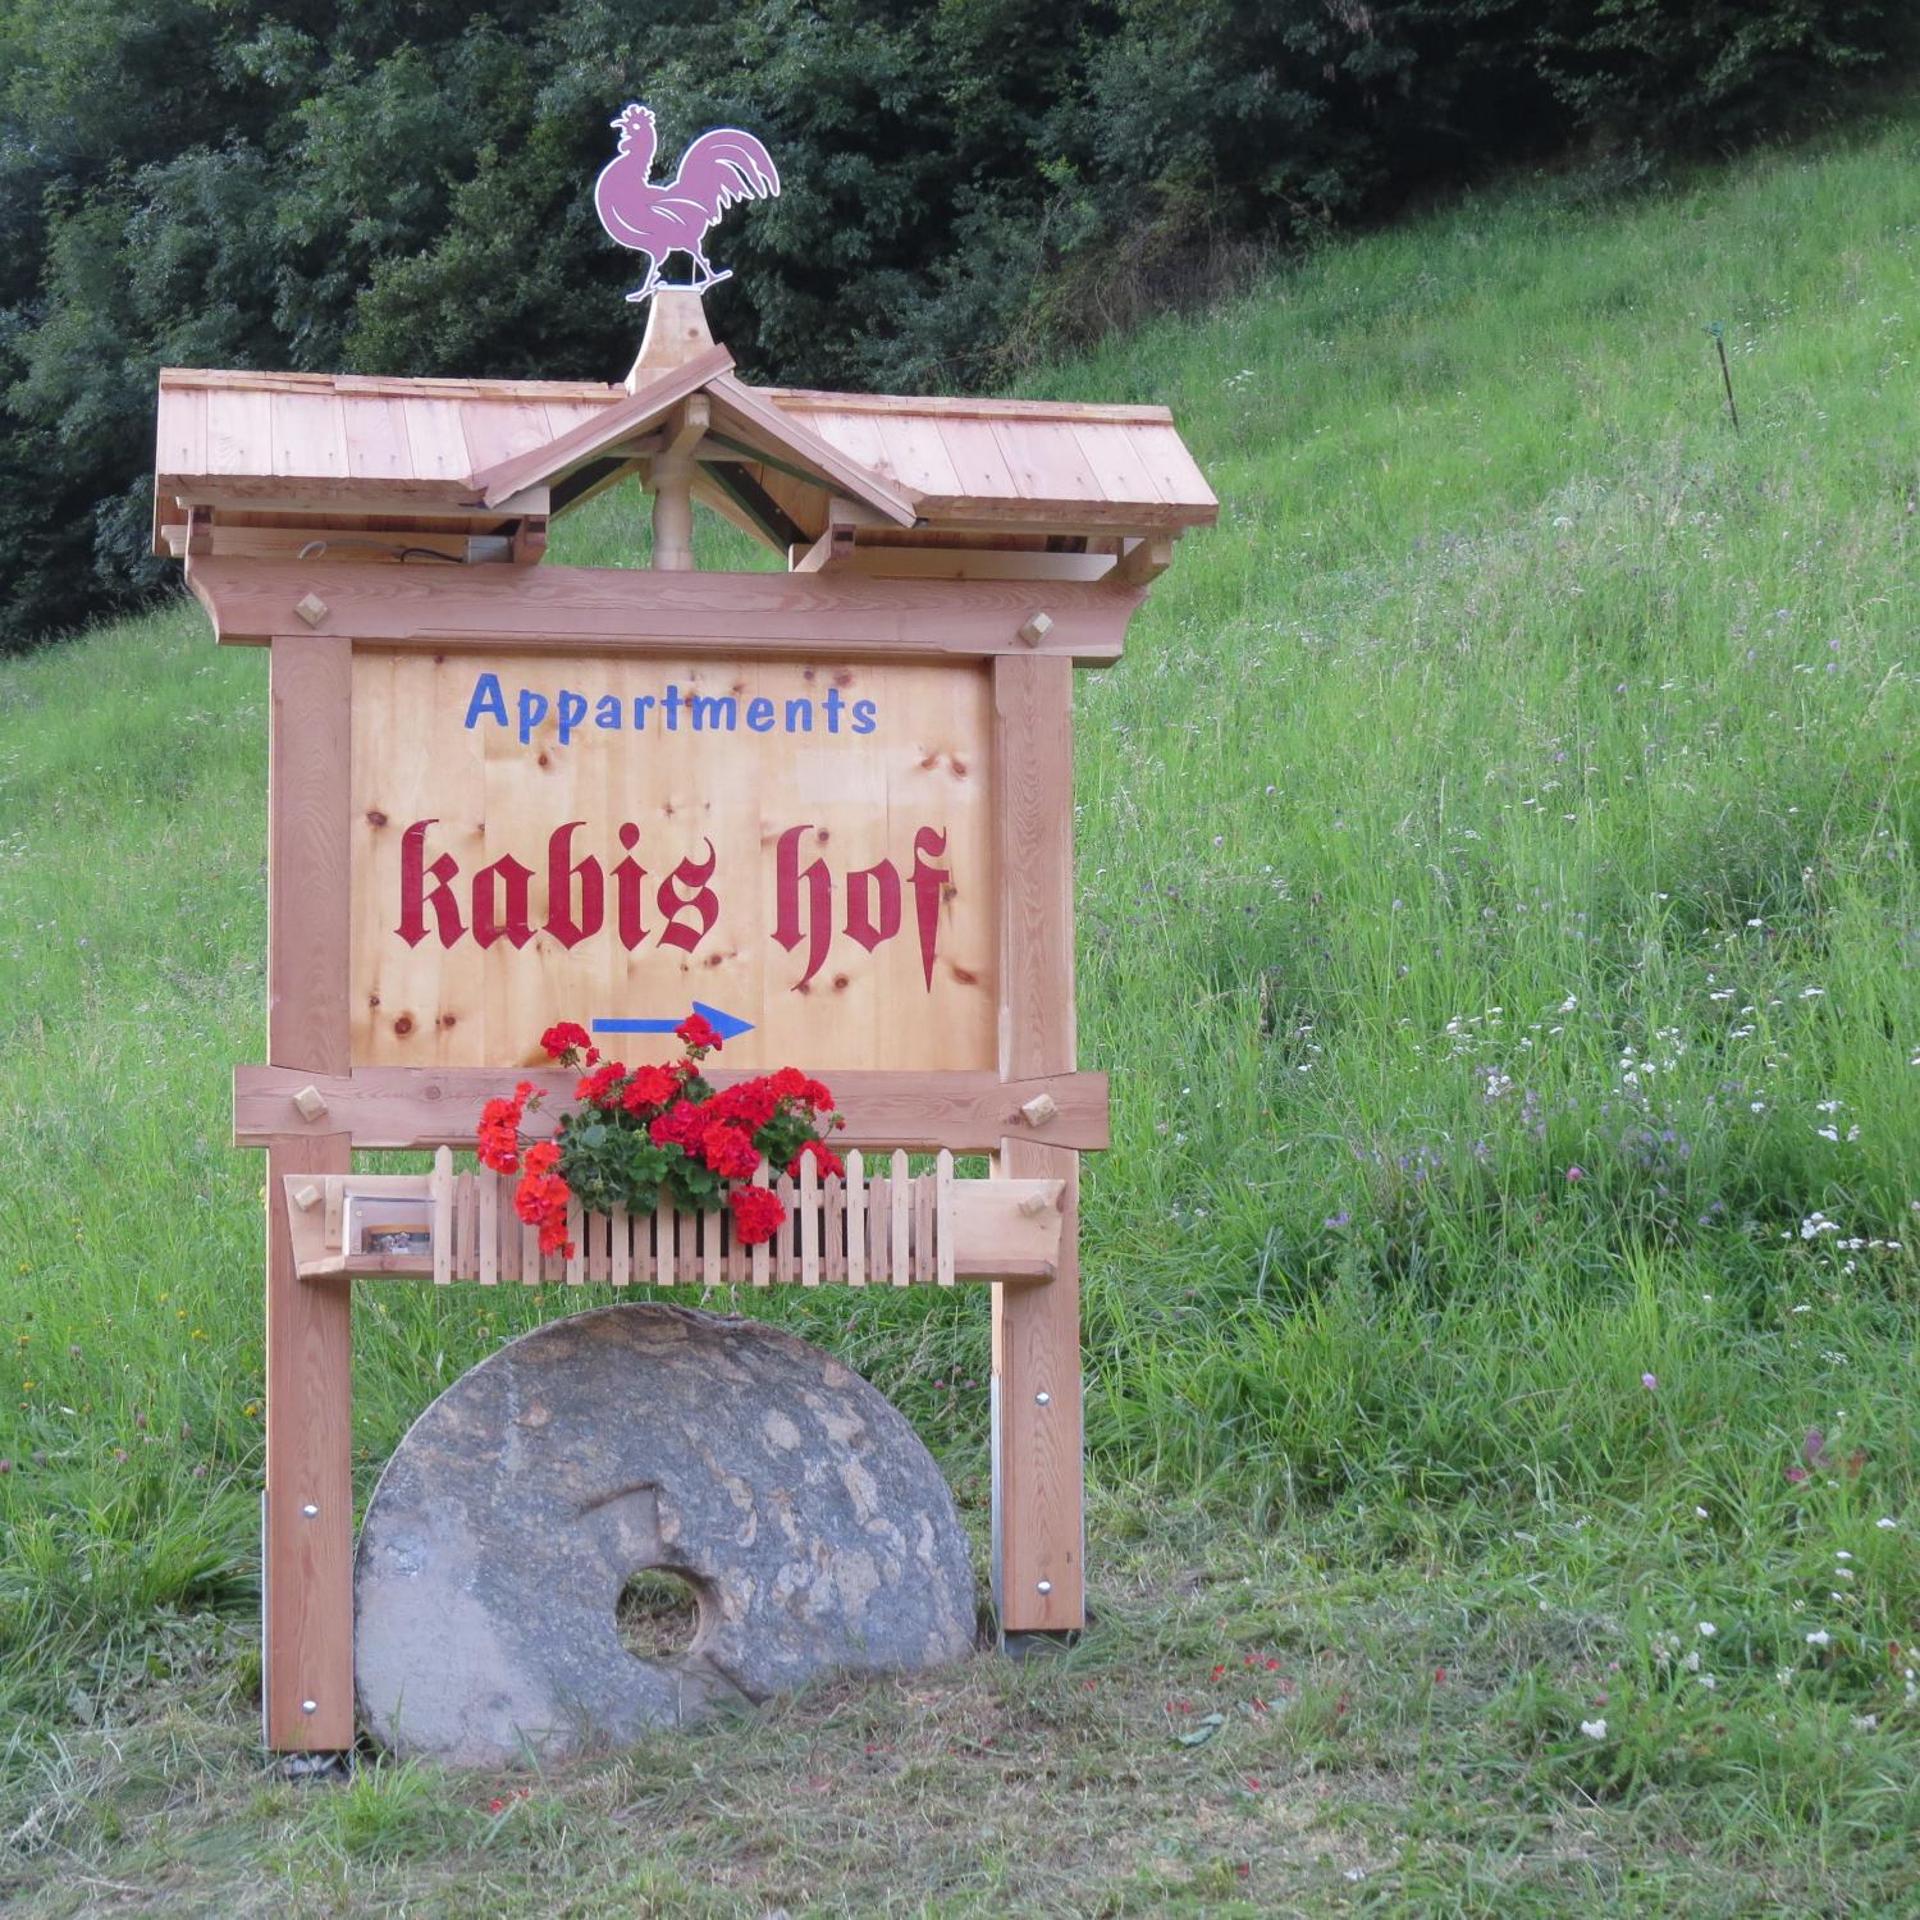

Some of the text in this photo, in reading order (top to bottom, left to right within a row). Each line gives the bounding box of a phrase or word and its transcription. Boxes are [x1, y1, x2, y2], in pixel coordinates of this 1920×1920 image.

[464, 673, 877, 745] Appartments
[394, 819, 951, 994] kabis hof
